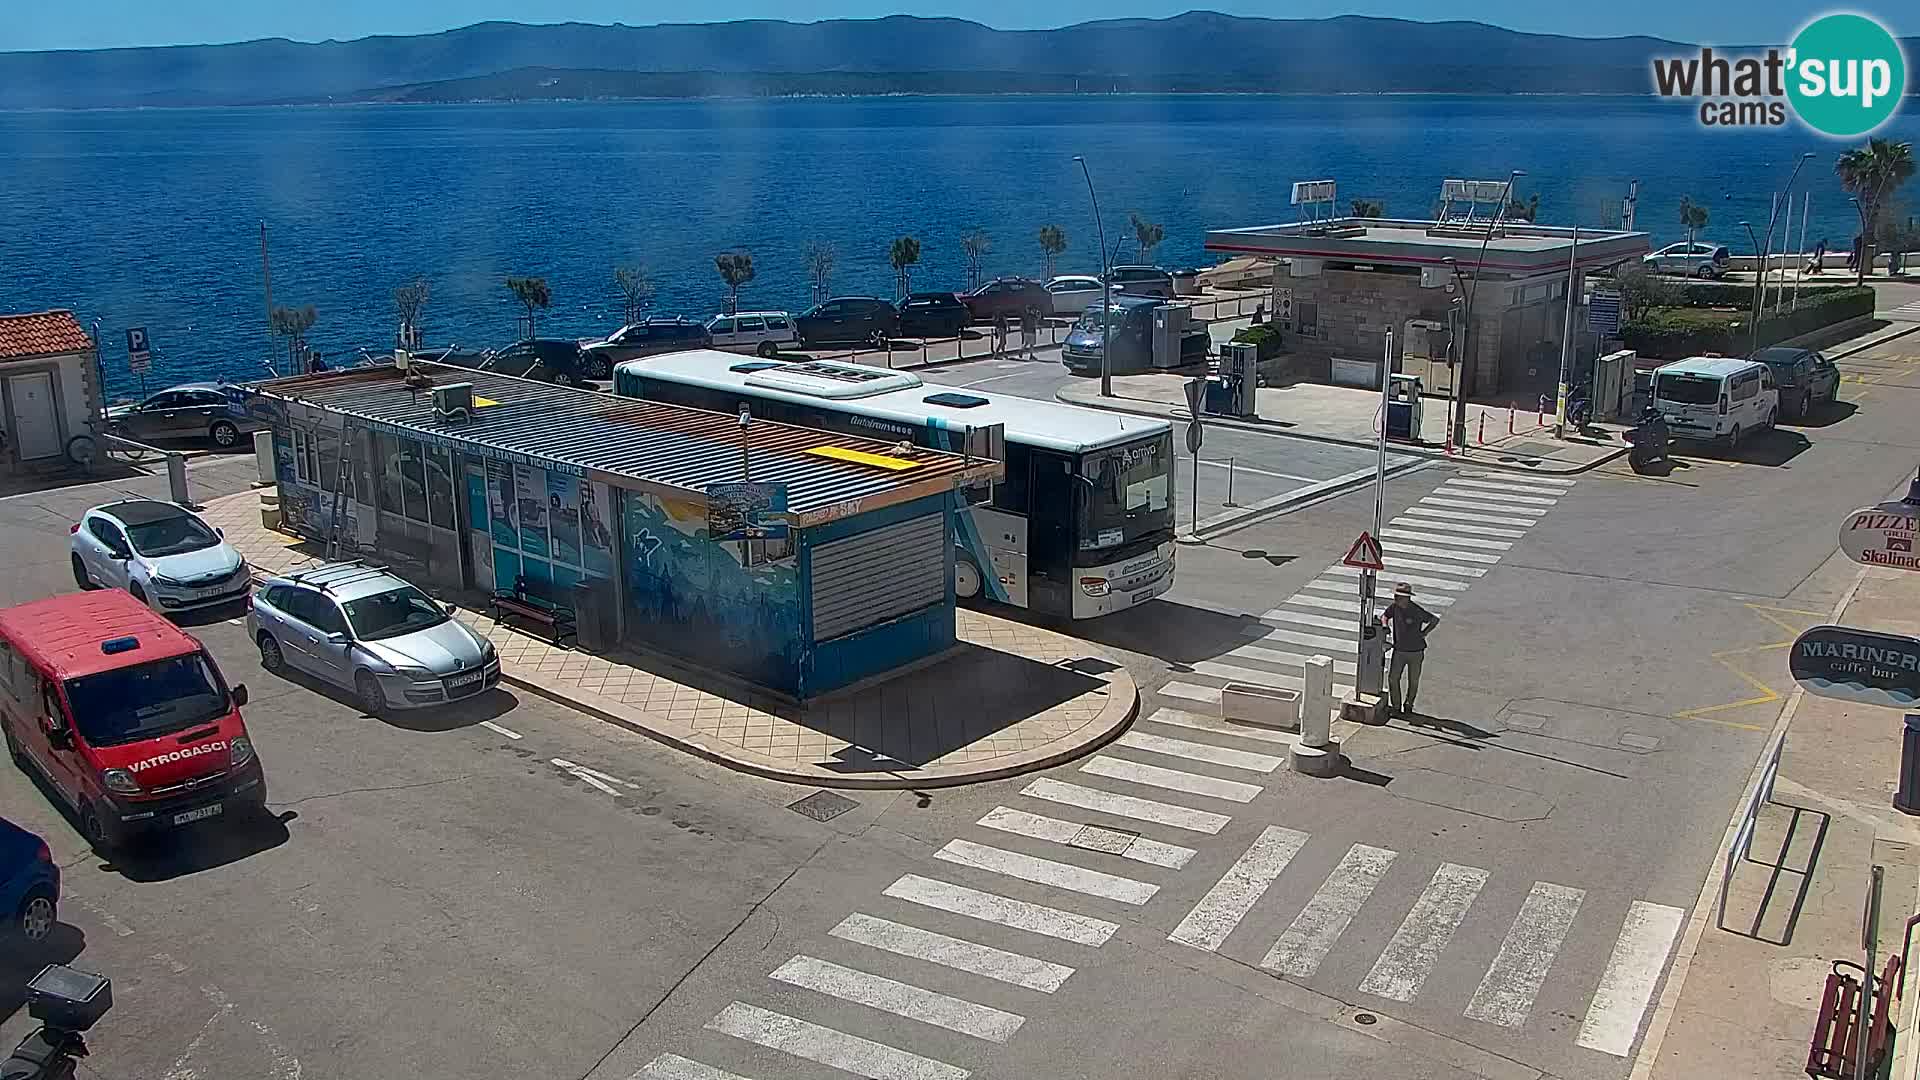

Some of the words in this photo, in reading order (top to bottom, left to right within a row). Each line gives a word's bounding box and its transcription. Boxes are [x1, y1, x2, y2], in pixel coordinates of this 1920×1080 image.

[131, 331, 144, 349] P
[850, 415, 890, 431] Autotrans
[438, 436, 468, 450] POSTAJA
[495, 450, 527, 465] STATION
[529, 457, 555, 471] TICKET
[556, 463, 583, 476] OFFICE
[1850, 514, 1920, 532] PIZZE
[1802, 641, 1920, 673] MARINER
[1830, 661, 1867, 673] caffe
[1871, 665, 1898, 680] bar
[128, 740, 228, 773] VATROGASCI
